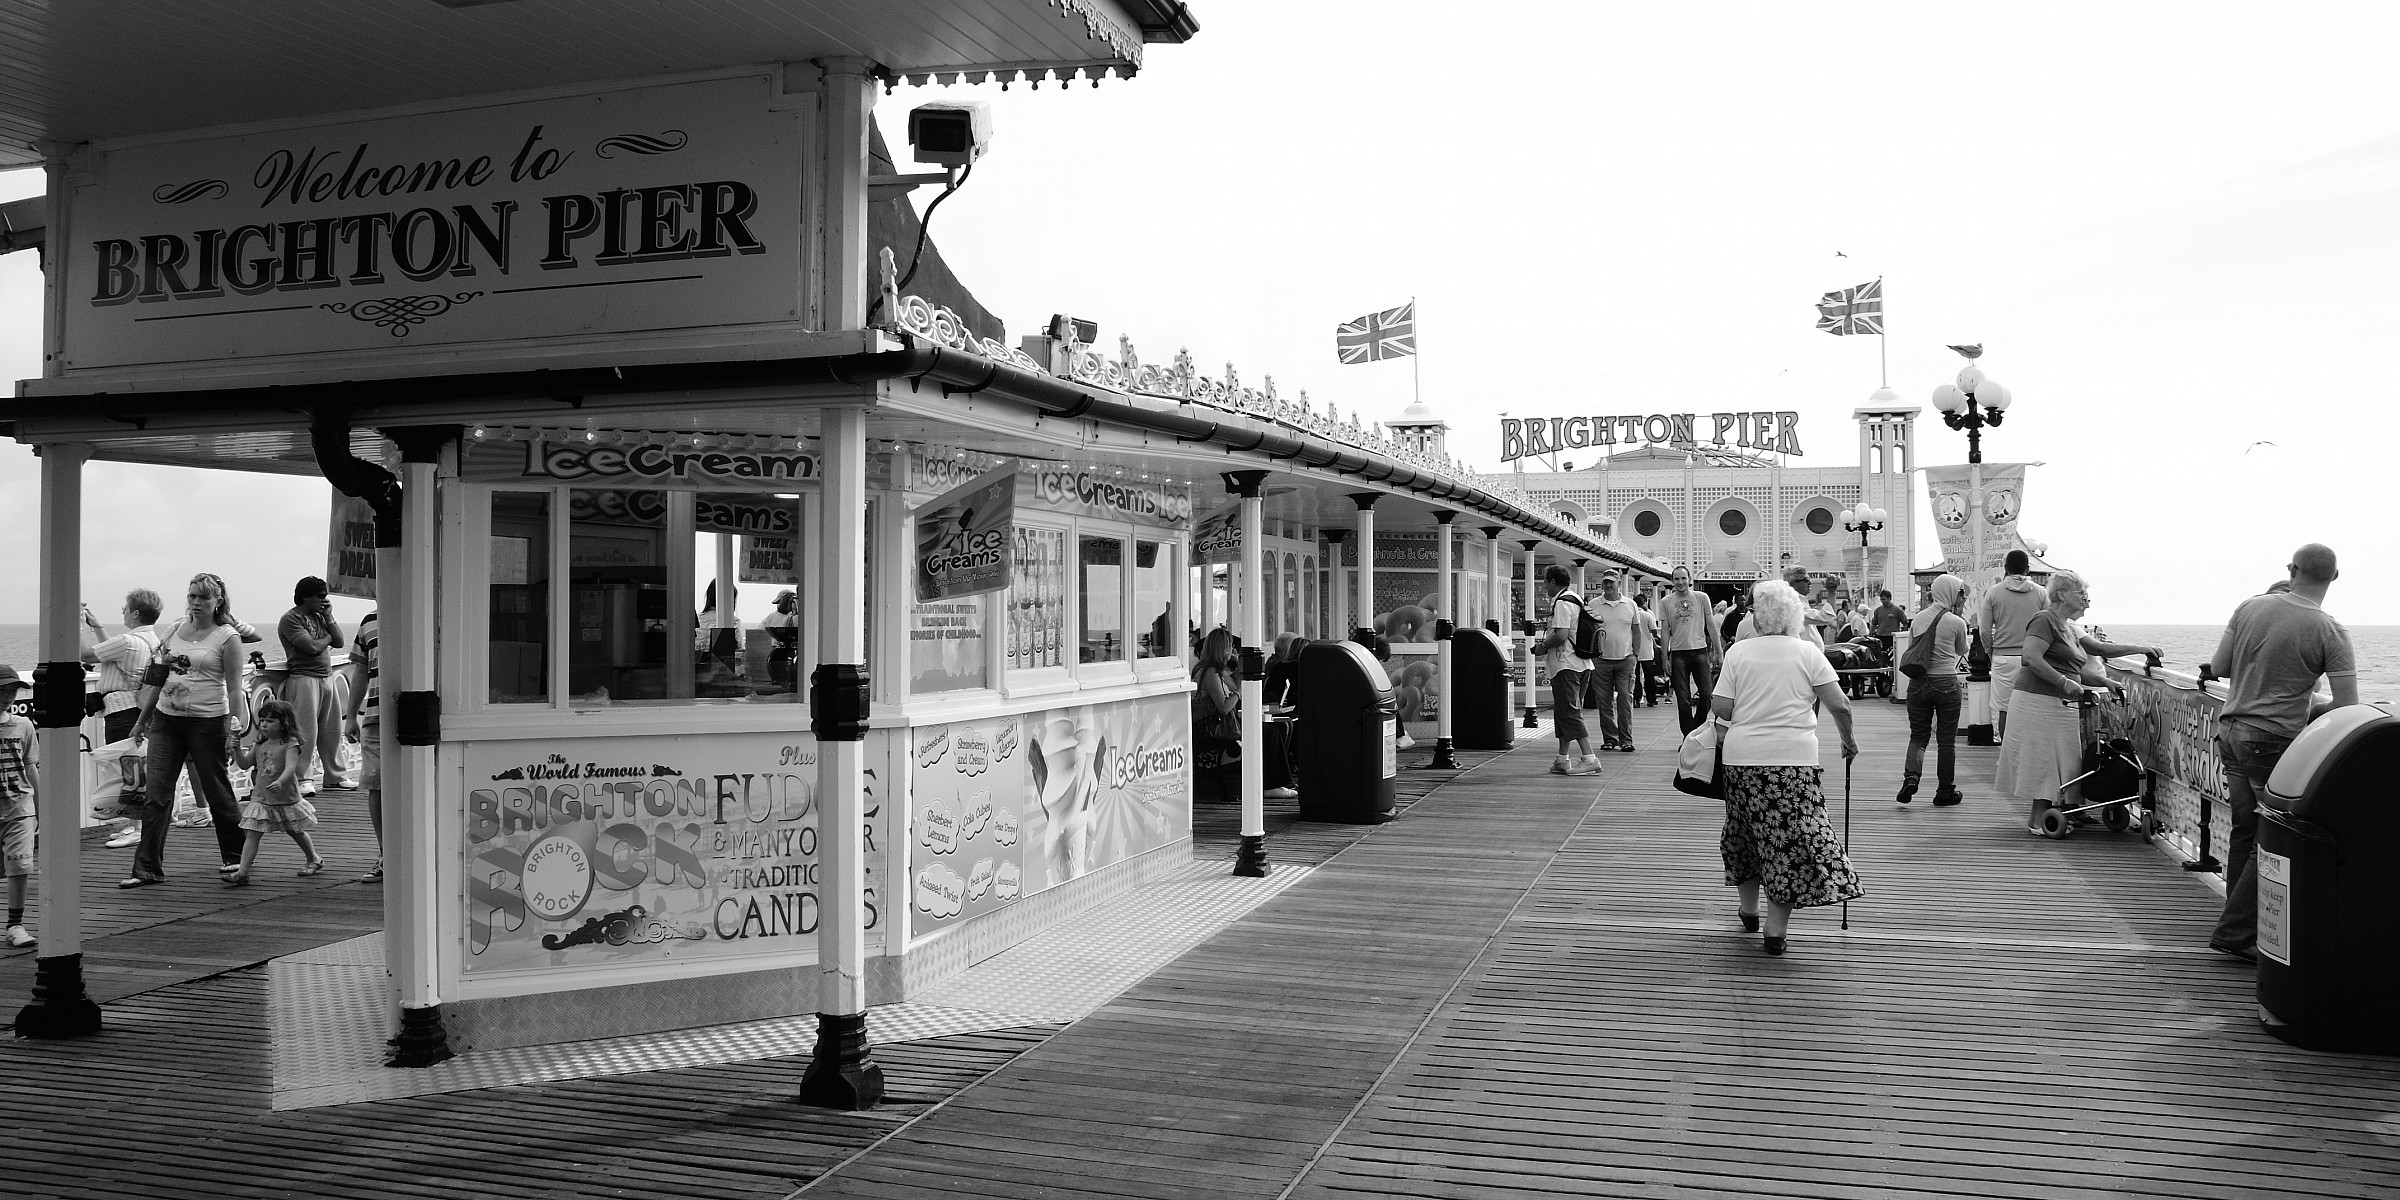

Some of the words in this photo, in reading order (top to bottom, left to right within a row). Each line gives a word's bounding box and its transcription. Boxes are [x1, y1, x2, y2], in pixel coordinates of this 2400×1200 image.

[254, 144, 497, 209] Welcome
[510, 125, 573, 183] to
[91, 200, 518, 307] BRIGHTON
[540, 178, 767, 272] PIER
[1501, 414, 1695, 462] BRIGHTON
[1712, 411, 1803, 456] PIER
[521, 440, 820, 480] IceCream
[1034, 472, 1157, 514] IceCreams
[960, 529, 1003, 555] Ice
[750, 551, 795, 570] DREAMS
[926, 549, 1002, 575] Creams
[910, 629, 935, 640] EMORIES
[547, 753, 567, 765] The
[778, 745, 816, 766] Plus
[1110, 744, 1184, 790] IceCreams
[2183, 737, 2231, 804] shake
[526, 763, 580, 780] World
[583, 763, 647, 779] Famous
[469, 777, 707, 843] BRIGHTON
[713, 768, 880, 825] FUDE
[976, 803, 991, 819] Cubes
[730, 827, 796, 860] MANY
[927, 826, 950, 844] Lemons
[528, 842, 585, 873] BRIGHTON
[533, 889, 580, 911] ROCK
[919, 874, 943, 897] Aniseed
[944, 887, 959, 904] Twist
[713, 887, 878, 941] CANDS
